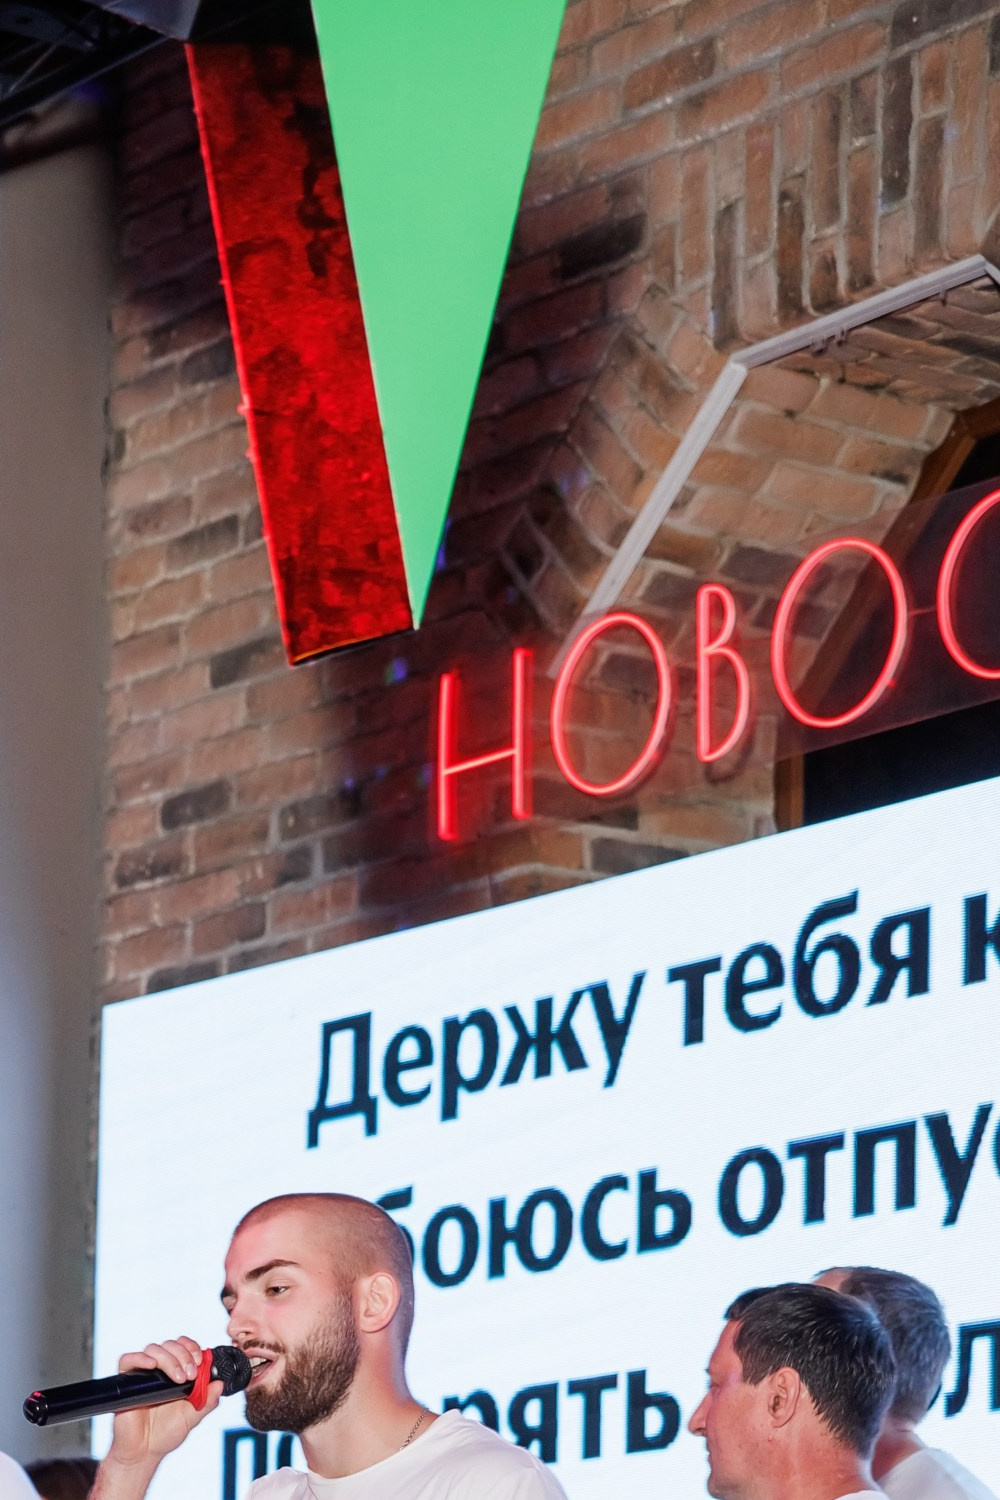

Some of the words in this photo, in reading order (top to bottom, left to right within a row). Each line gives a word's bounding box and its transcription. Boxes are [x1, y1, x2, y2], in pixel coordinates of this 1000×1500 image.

[306, 970, 647, 1149] Держу
[667, 889, 932, 1049] тебя
[717, 1102, 1000, 1239] отпу
